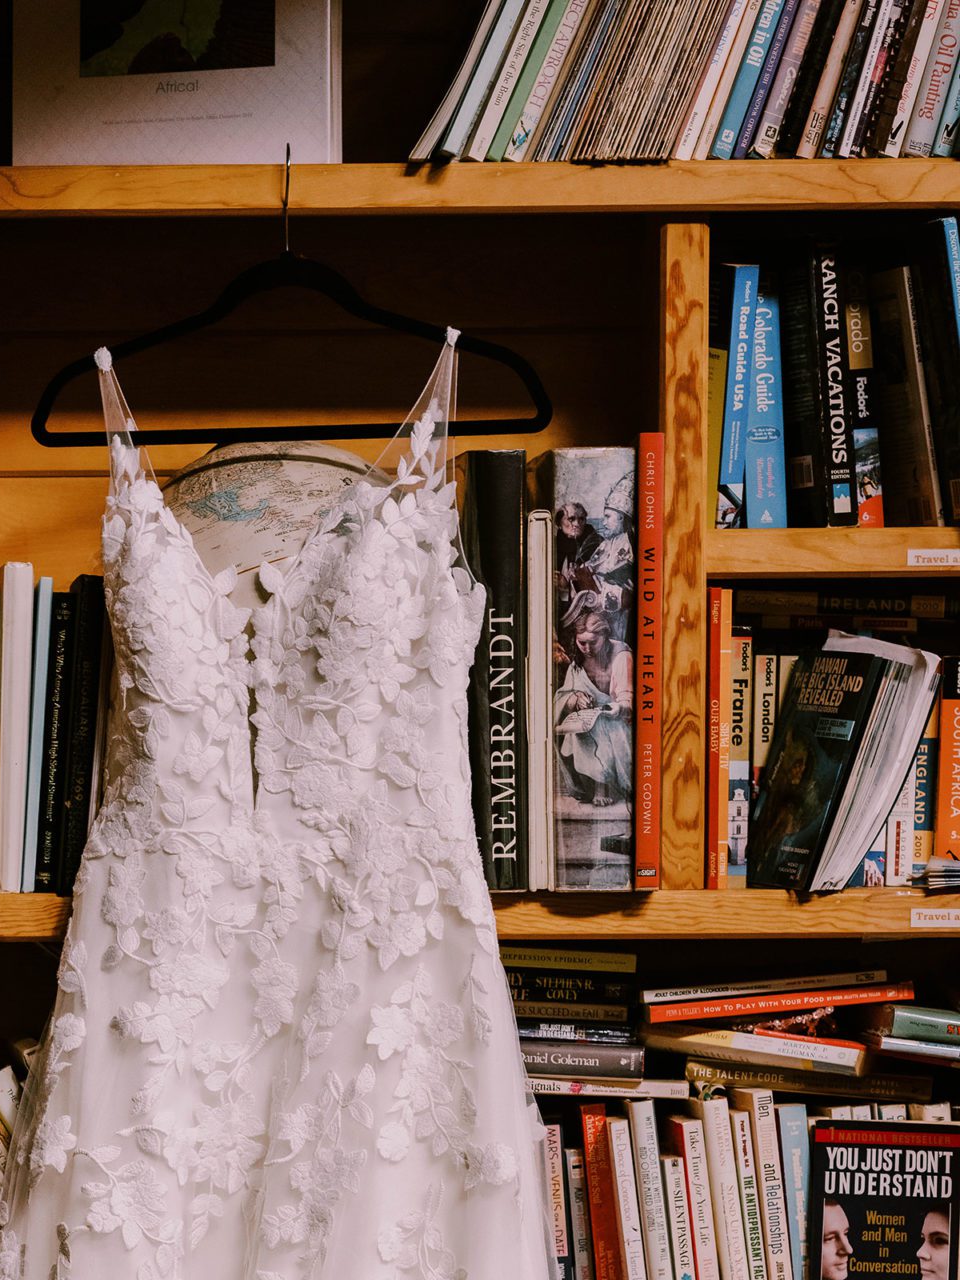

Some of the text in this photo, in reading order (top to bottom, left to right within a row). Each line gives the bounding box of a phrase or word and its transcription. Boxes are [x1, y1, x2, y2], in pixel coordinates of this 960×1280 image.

[938, 35, 957, 62] Oil
[530, 34, 569, 108] APPROACH
[918, 61, 952, 120] Painting
[738, 306, 750, 339] Road
[754, 308, 773, 370] Colorado
[736, 342, 747, 380] Guide
[733, 384, 744, 411] USA
[756, 373, 775, 412] Guide
[826, 338, 847, 464] VACATIONS
[856, 377, 870, 418] Fodor's
[645, 452, 654, 530] CHRIS JOHNS
[915, 555, 948, 563] Travel
[644, 546, 654, 725] WILD AT HEART
[794, 672, 864, 692] THE BIG ISLAND
[812, 657, 848, 674] HAWAII
[732, 642, 750, 746] Fodor's France
[762, 658, 774, 742] Fodor's London
[797, 688, 844, 706] REVEALED
[490, 608, 515, 862] REMBRANDT
[642, 743, 652, 835] PETER GODWIN
[914, 744, 927, 824] ENGLAND
[916, 912, 949, 921] Travel
[694, 1068, 784, 1083] THE TALENT CODE
[840, 1132, 950, 1144] NATIONAL BESTSELLER
[757, 1095, 784, 1254] Men, Women and Relationships
[826, 1147, 953, 1174] YOU JUST DON'T
[744, 1176, 754, 1190] THE
[824, 1172, 952, 1198] UNDERSTAND
[745, 1194, 762, 1262] ANTIDEPRESSANT
[862, 1228, 907, 1242] and Men
[866, 1211, 905, 1226] Women
[850, 1258, 918, 1274] Conversation
[880, 1244, 889, 1257] in
